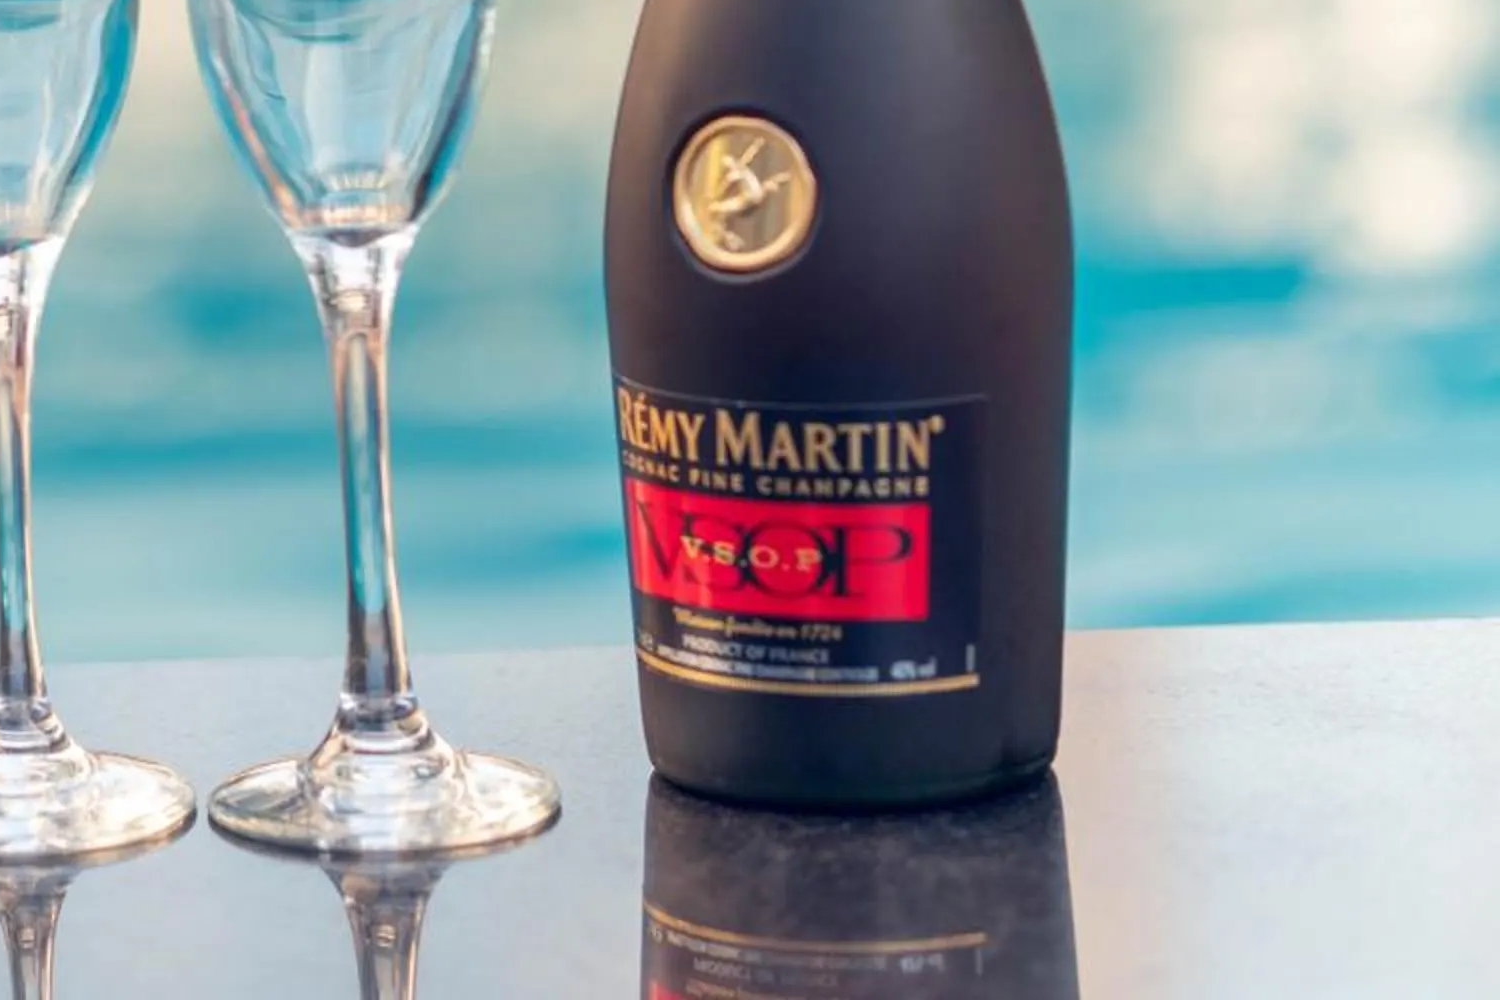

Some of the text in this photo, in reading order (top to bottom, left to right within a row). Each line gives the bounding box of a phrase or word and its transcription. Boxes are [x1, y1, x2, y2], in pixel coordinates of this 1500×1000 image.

[618, 388, 931, 472] RÉMY MARTIN
[688, 468, 745, 493] FINE
[756, 475, 930, 498] CHAMPAGNE
